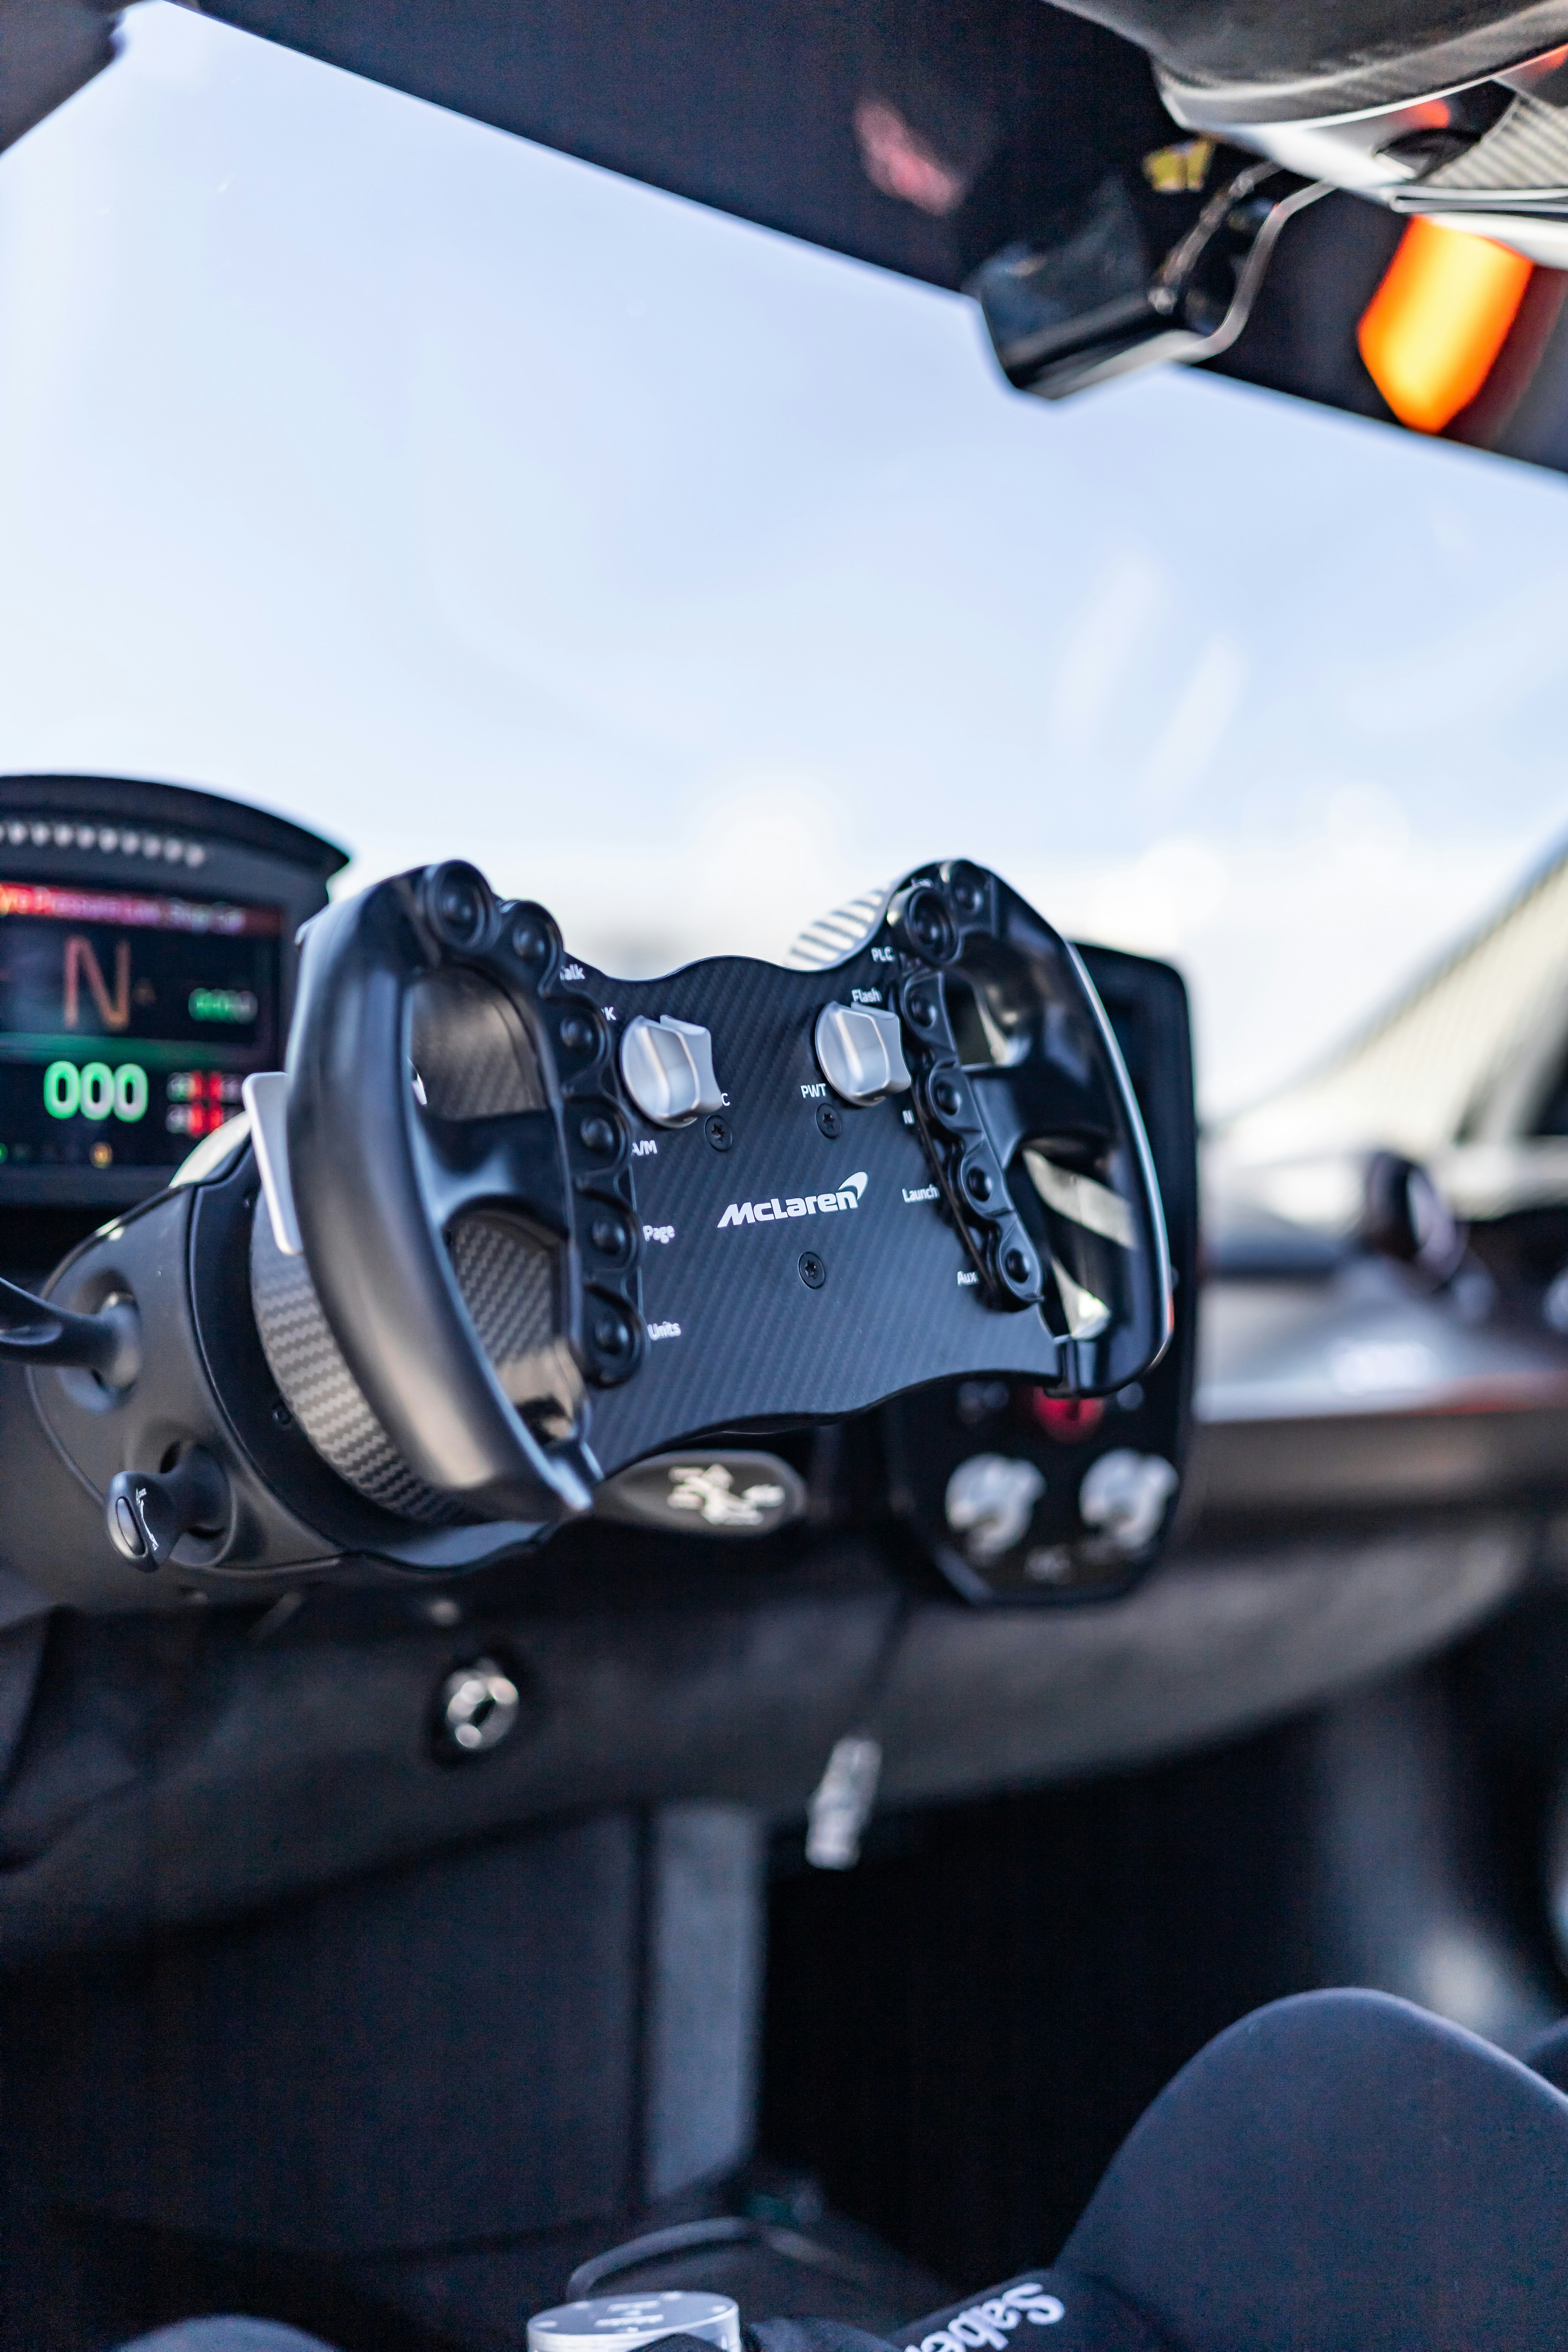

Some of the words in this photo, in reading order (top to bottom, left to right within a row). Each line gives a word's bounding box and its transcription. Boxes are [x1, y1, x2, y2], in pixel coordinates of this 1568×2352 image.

[871, 946, 896, 962] PLC
[63, 936, 132, 1031] N
[851, 986, 882, 1003] Flash
[44, 1061, 149, 1122] 000
[801, 1083, 827, 1098] PWT
[902, 1184, 939, 1203] Launch
[717, 1190, 859, 1228] McLaren
[642, 1225, 675, 1244] Page
[957, 1271, 979, 1286] Aux
[647, 1321, 681, 1340] Units
[905, 2282, 1065, 2352] Sabe
